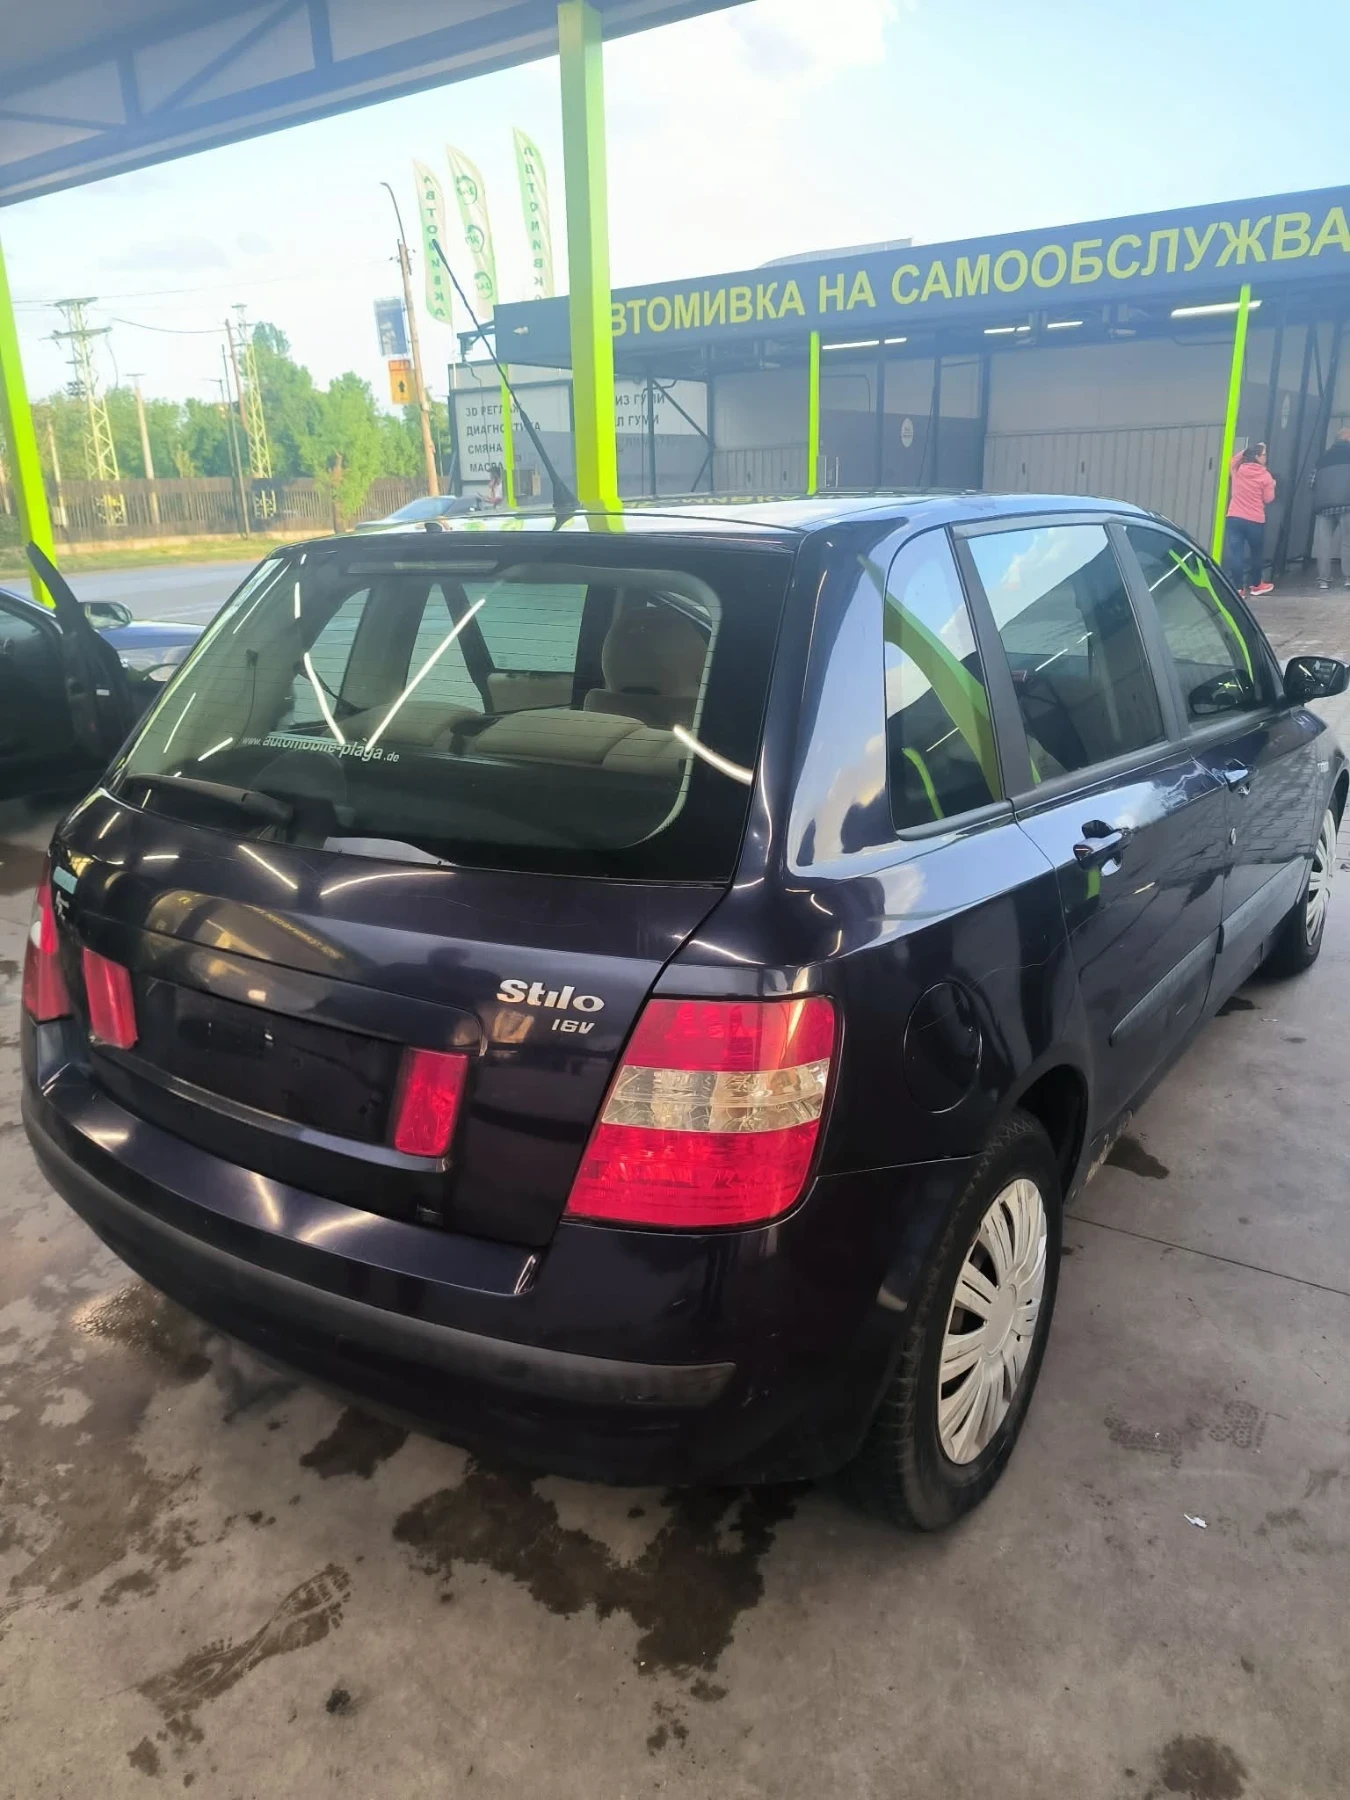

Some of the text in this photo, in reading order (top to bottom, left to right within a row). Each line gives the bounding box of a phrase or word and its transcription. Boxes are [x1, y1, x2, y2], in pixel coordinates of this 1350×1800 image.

[611, 206, 1350, 337] ВТОМИВКА НА САМООБСЛУЖВА
[467, 443, 504, 455] СМЯНА
[496, 979, 605, 1013] Stilo
[551, 1018, 596, 1035] 16V
